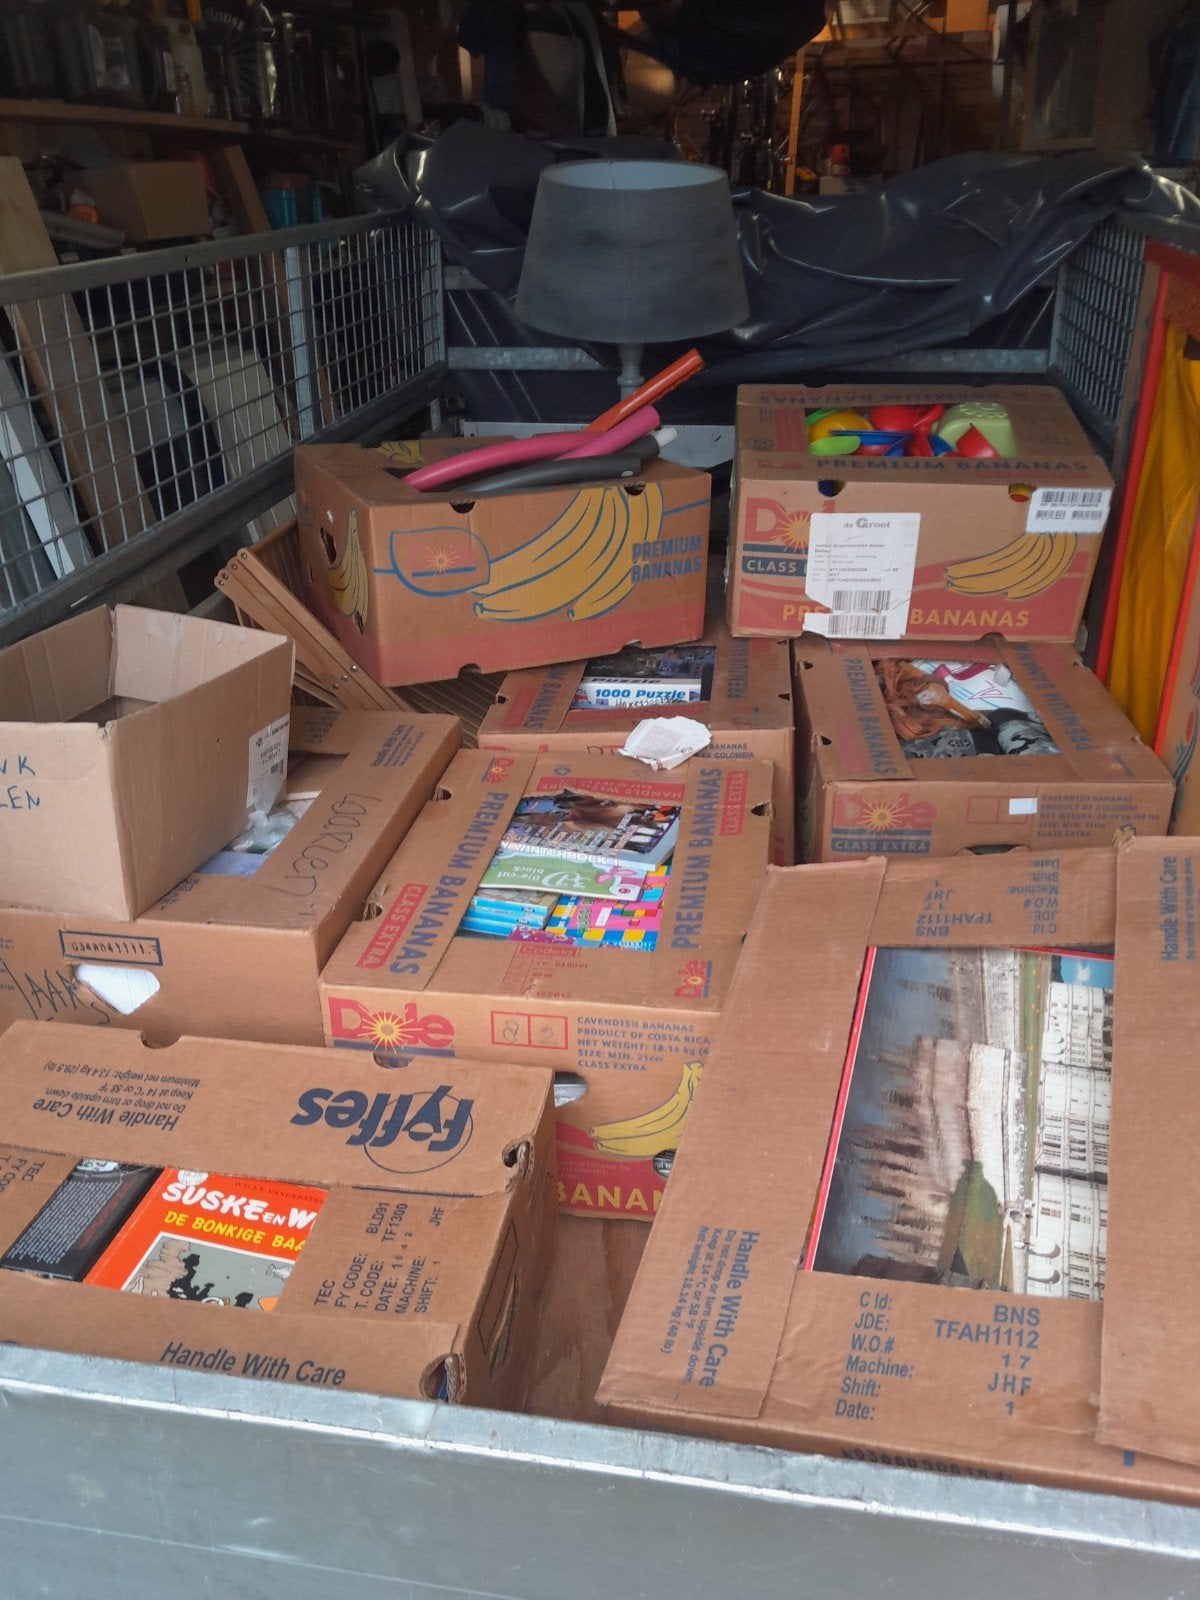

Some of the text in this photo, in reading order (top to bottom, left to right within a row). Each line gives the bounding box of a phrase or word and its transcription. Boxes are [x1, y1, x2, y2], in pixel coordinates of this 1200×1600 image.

[817, 459, 1086, 470] PREMIUM BANANAS
[632, 535, 701, 559] PREMIUM
[632, 559, 701, 583] BANANAS
[746, 559, 797, 573] CLASS
[911, 609, 1030, 627] BANANAS
[844, 659, 876, 711] PREMIUM
[595, 688, 686, 700] 1000 Puzzle
[859, 716, 898, 773] BANANAS
[0, 786, 41, 810] EN
[724, 772, 747, 836] CLASS EXTRA
[834, 792, 938, 829] Dole
[448, 791, 510, 869] PREMIUM
[516, 843, 607, 865] WINTERBOEK
[835, 839, 927, 852] CLASS EXTRA
[671, 768, 722, 951] PREMIUM BANANAS
[1031, 858, 1060, 868] Date:
[1031, 872, 1059, 881] Shift:
[1007, 885, 1059, 895] Machine:
[1031, 911, 1058, 921] JDE:
[1159, 855, 1180, 961] Handle With Care
[361, 885, 424, 966] CLASS EXTRA
[389, 875, 467, 974] BANANAS
[916, 912, 994, 925] TFAH1112
[915, 925, 949, 937] BNS
[328, 998, 455, 1049] Dole
[577, 1016, 694, 1033] CAVENDISH BANANAS
[577, 1028, 626, 1038] PRODUCT
[648, 1034, 681, 1043] COSTA
[684, 1036, 711, 1045] RICA
[577, 1039, 599, 1047] NET
[602, 1040, 648, 1051] WEIGHT:
[683, 1046, 696, 1056] kg
[577, 1050, 605, 1058] SIZE:
[637, 1054, 664, 1063] 21cm
[80, 1064, 91, 1075] kg
[577, 1060, 647, 1072] CLASS EXTRA
[113, 1069, 144, 1081] weight:
[144, 1073, 158, 1082] net
[161, 1075, 201, 1088] Minimum
[45, 1087, 71, 1099] down.
[71, 1091, 102, 1102] upside
[123, 1085, 134, 1093] or
[146, 1087, 157, 1097] 14
[159, 1088, 169, 1098] at
[171, 1089, 194, 1101] Keep
[104, 1097, 121, 1106] turn
[134, 1100, 155, 1110] drop
[157, 1102, 171, 1112] not
[172, 1104, 186, 1114] Do
[33, 1098, 180, 1131] Handle With Care
[21, 1161, 46, 1182] TEC
[235, 1180, 264, 1195] WILLY
[161, 1182, 269, 1221] SUSKE
[288, 1207, 317, 1230] W
[428, 1206, 446, 1227] JHF
[164, 1210, 189, 1227] DE
[191, 1216, 266, 1245] BONKIGE
[697, 1225, 710, 1243] Net
[725, 1229, 738, 1243] Do
[707, 1227, 723, 1251] Keep
[334, 1202, 390, 1309] FY CODE: BLD91
[353, 1202, 409, 1310] T. CODE: TF1300
[705, 1251, 715, 1263] at
[720, 1245, 731, 1260] not
[700, 1263, 713, 1276] 14
[712, 1260, 727, 1282] drop
[313, 1279, 336, 1306] TEC
[394, 1255, 428, 1314] MACHINE:
[709, 1283, 719, 1295] or
[374, 1277, 399, 1312] DATE:
[414, 1277, 439, 1314] SHIFT:
[693, 1290, 703, 1302] or
[859, 1291, 870, 1308] C
[670, 1306, 686, 1320] kg
[688, 1303, 700, 1317] 58
[700, 1230, 760, 1388] Handle With Care
[703, 1296, 717, 1317] turn
[854, 1312, 890, 1332] JDE:
[993, 1304, 1041, 1327] BNS
[667, 1320, 681, 1339] (40
[693, 1319, 709, 1353] upside
[934, 1318, 1040, 1350] TFAH1112
[660, 1339, 676, 1356] lb)
[160, 1341, 346, 1386] Handle With Care
[845, 1354, 915, 1380] Machine:
[840, 1376, 882, 1398] Shift:
[834, 1399, 877, 1421] Date:
[1004, 1401, 1014, 1416] 1
